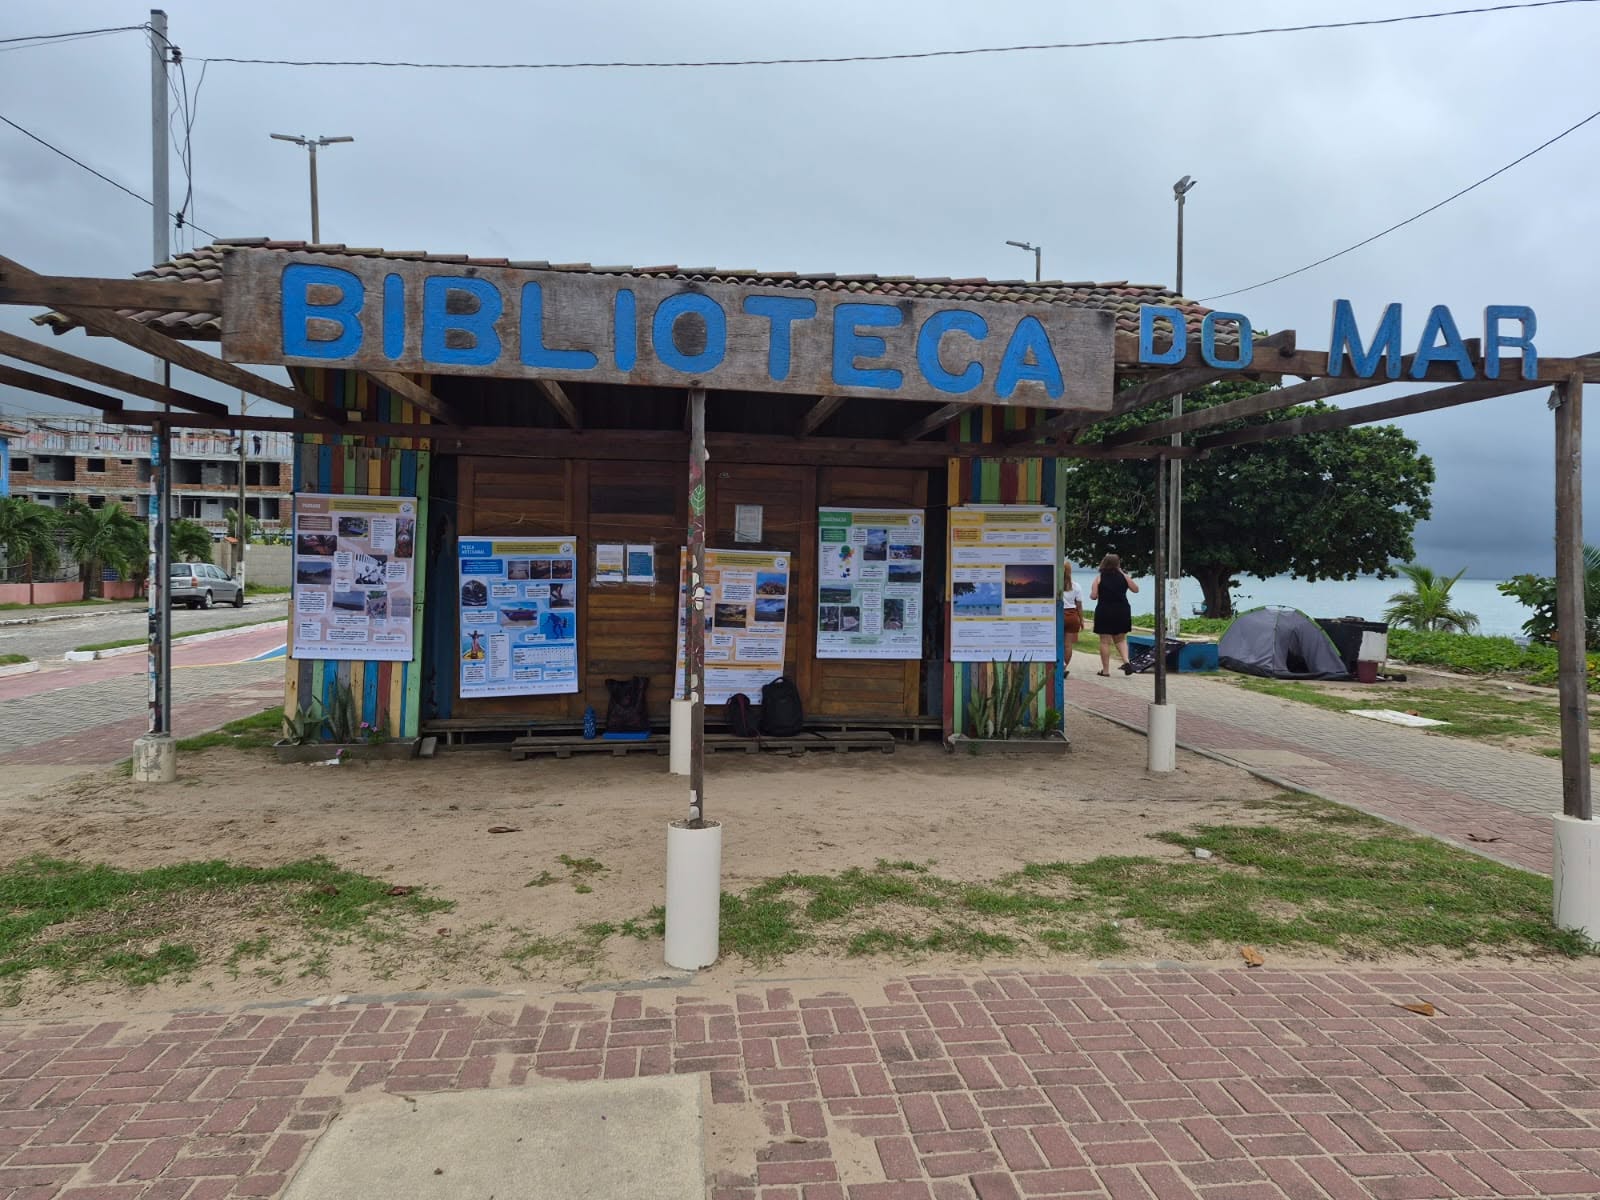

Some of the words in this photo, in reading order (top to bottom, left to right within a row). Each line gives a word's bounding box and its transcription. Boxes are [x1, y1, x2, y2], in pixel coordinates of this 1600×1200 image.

[281, 262, 1064, 400] BIBLIOTECA
[1139, 304, 1254, 370] DO
[1327, 299, 1538, 380] MAR
